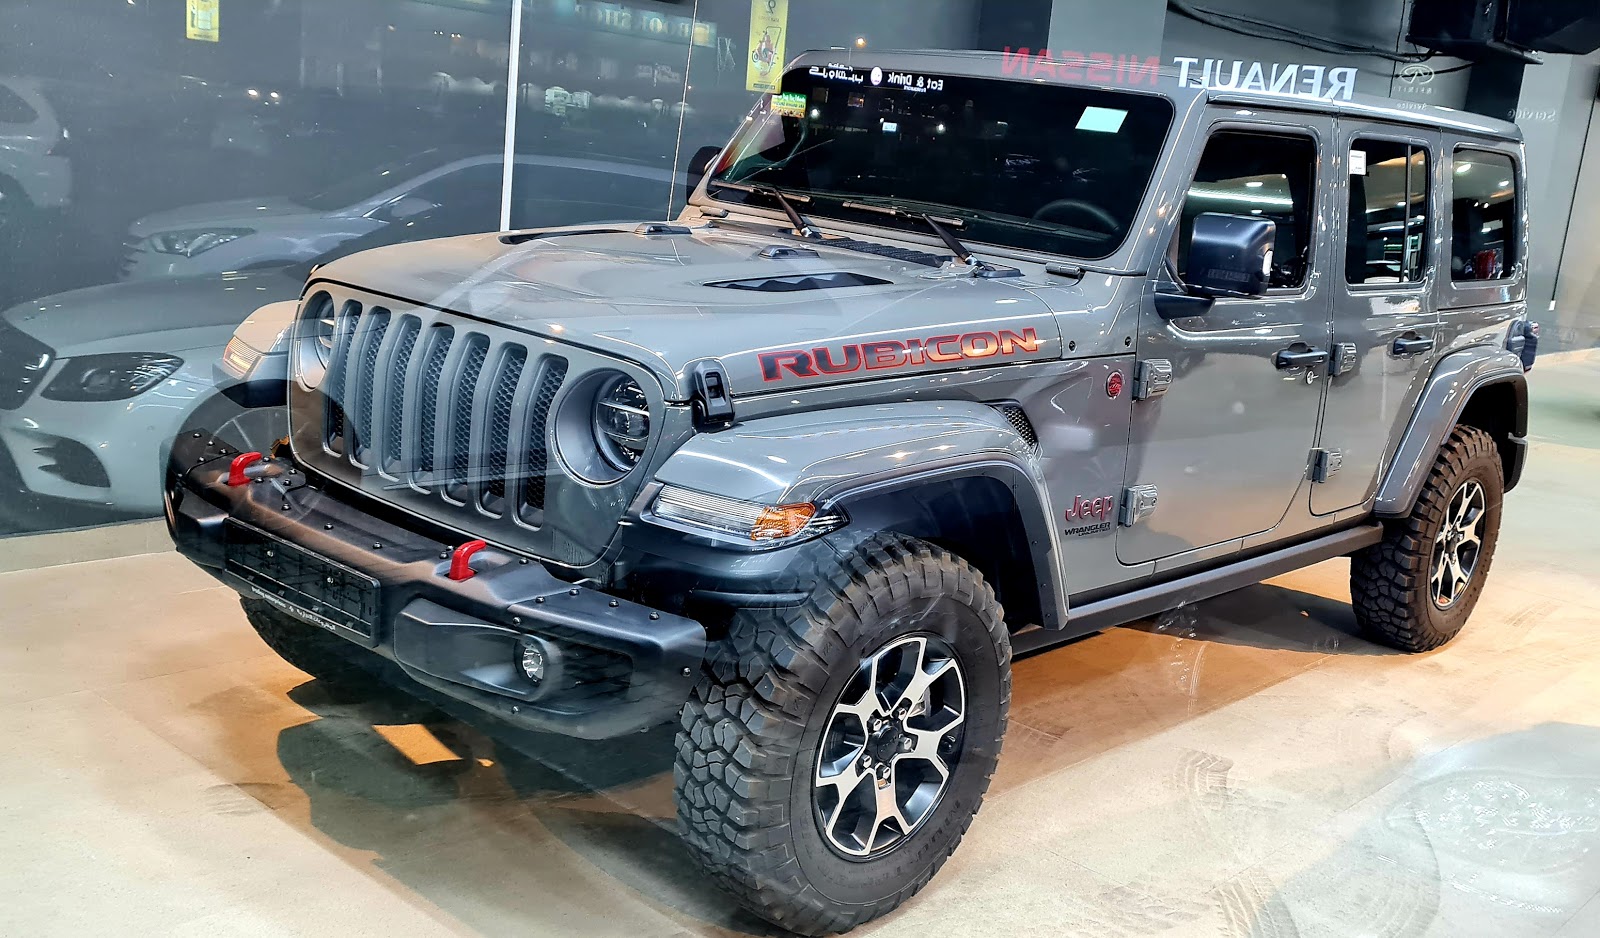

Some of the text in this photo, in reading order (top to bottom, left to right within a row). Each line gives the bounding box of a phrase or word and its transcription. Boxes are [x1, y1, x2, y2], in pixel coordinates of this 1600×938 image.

[758, 327, 1038, 382] RUBICON
[1065, 495, 1114, 522] Jeep
[1064, 522, 1111, 536] WRANGLER
